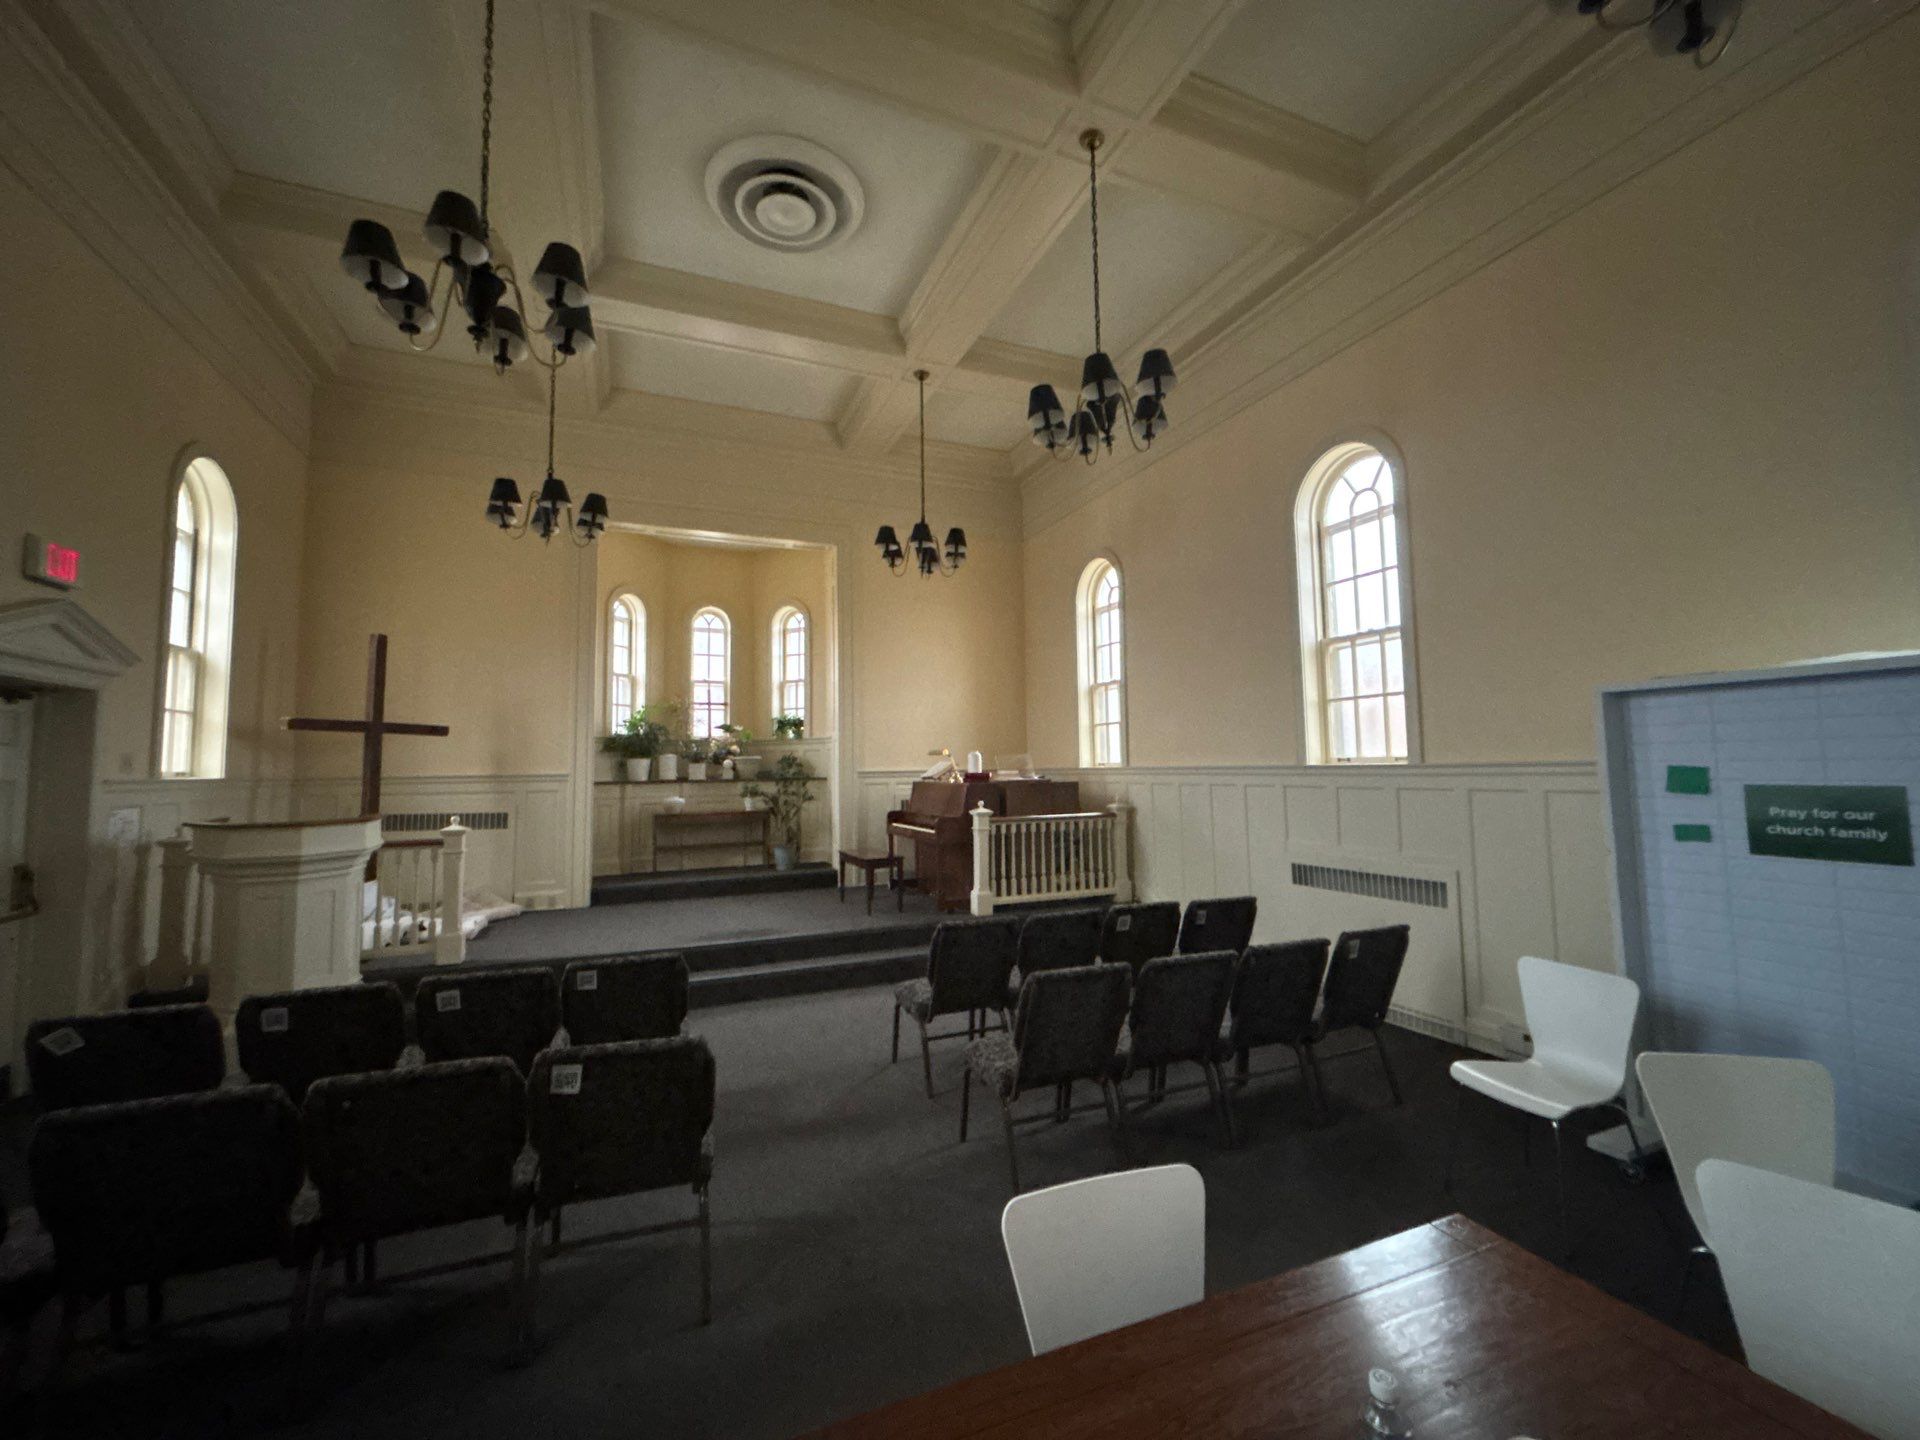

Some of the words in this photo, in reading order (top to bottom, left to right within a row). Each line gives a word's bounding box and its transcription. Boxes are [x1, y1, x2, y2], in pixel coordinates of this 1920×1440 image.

[1768, 806, 1807, 821] Pray
[1812, 807, 1839, 820] for
[1843, 810, 1876, 821] our
[1765, 824, 1825, 837] church
[1829, 826, 1888, 842] family
